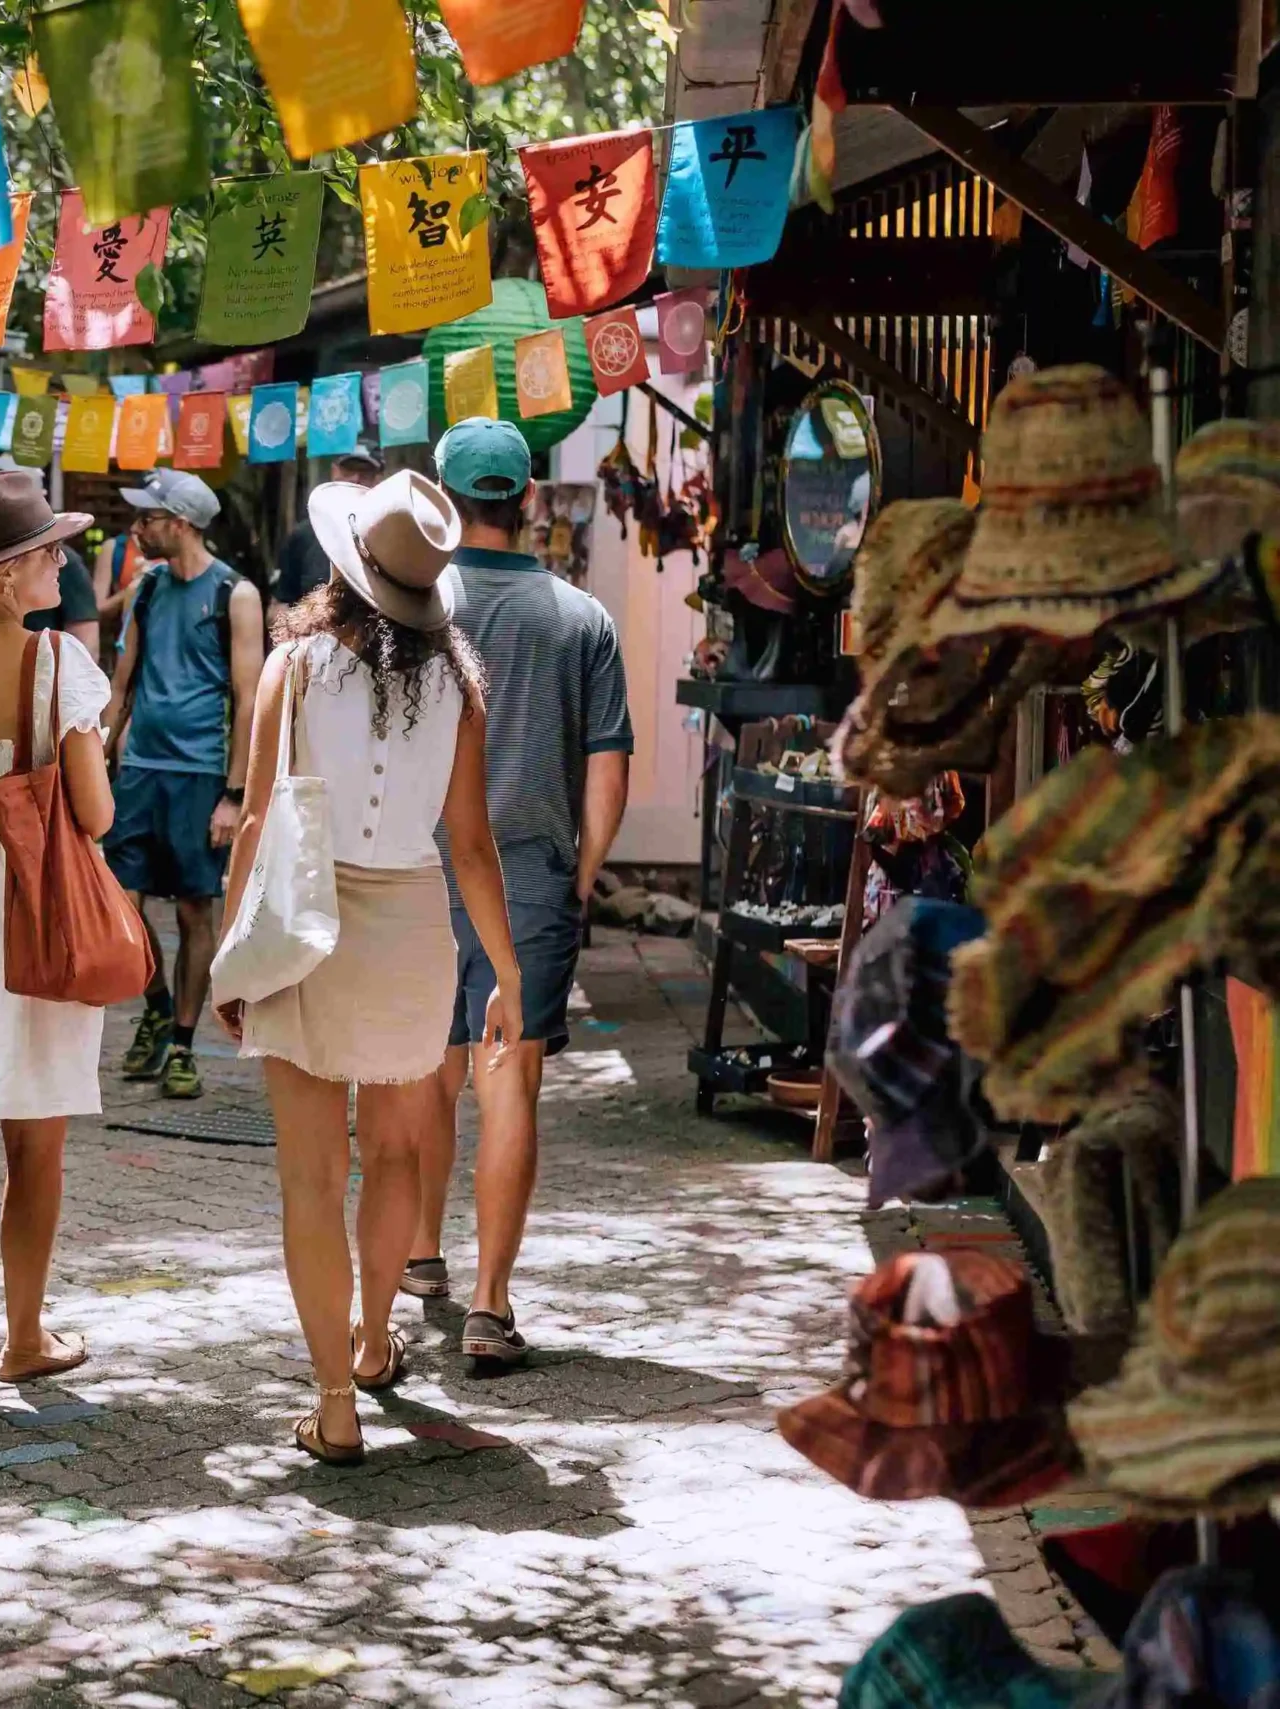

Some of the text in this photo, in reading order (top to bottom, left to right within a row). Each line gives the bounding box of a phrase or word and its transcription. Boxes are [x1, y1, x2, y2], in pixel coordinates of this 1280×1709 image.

[709, 125, 767, 190] 平
[407, 191, 451, 248] 智
[574, 164, 622, 231] 安
[252, 211, 287, 261] 英
